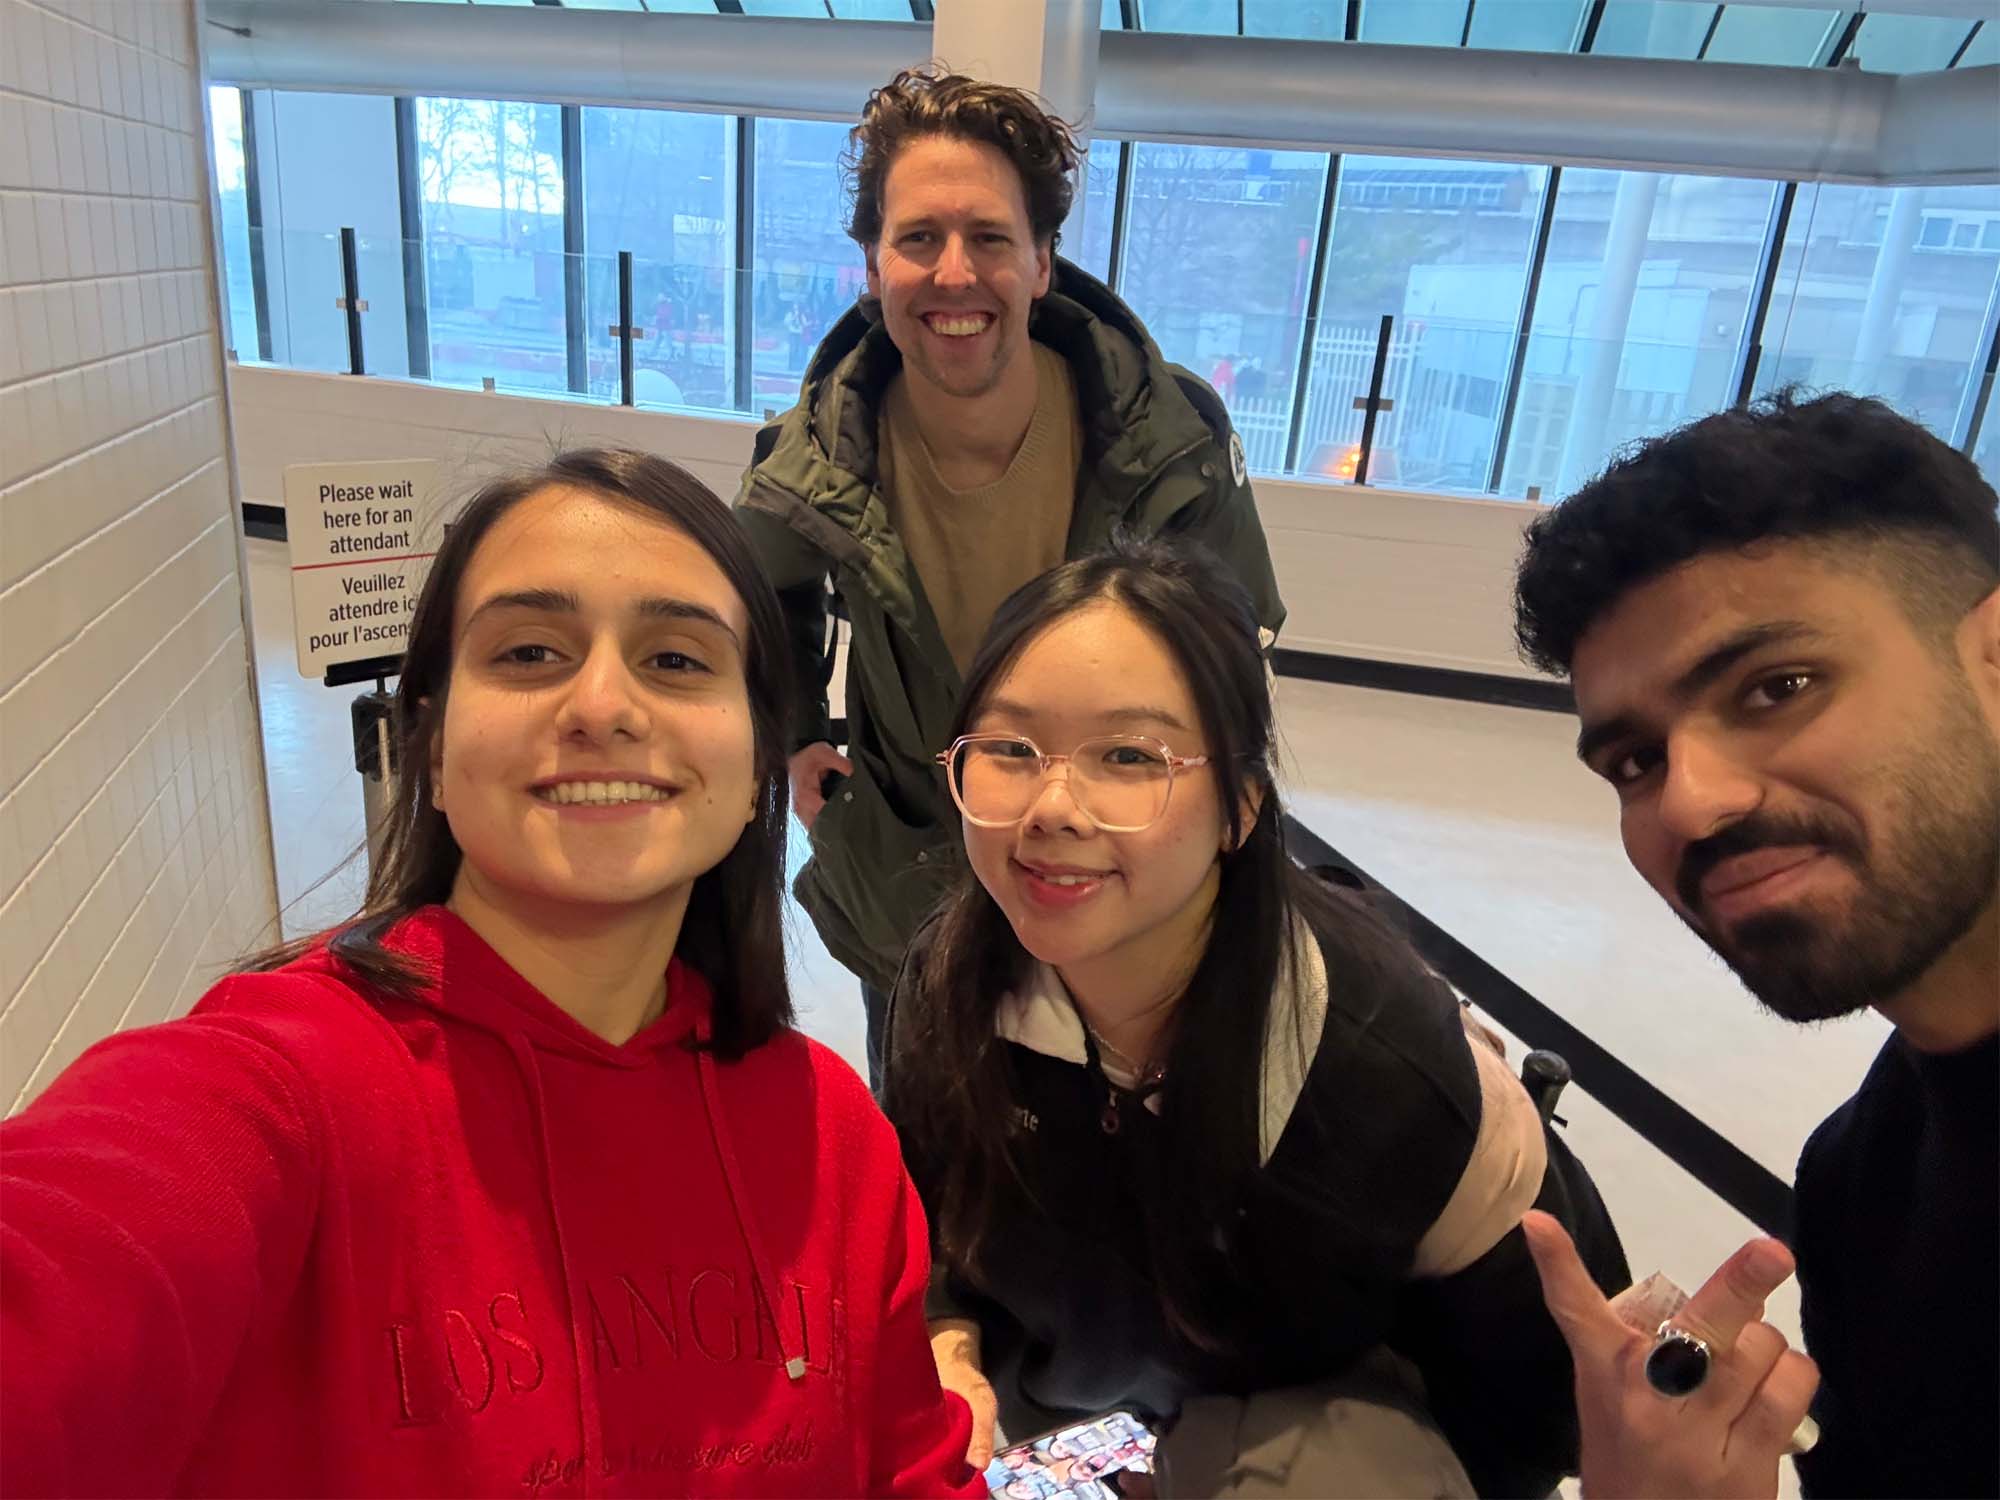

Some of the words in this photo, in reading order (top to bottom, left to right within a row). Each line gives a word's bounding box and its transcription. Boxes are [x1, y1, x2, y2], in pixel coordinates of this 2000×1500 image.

[320, 483, 375, 504] Please
[378, 480, 414, 499] wait
[324, 511, 361, 529] here
[366, 507, 389, 524] for
[394, 508, 413, 523] an
[330, 531, 410, 554] attendant
[342, 573, 405, 595] Veuillez
[329, 598, 399, 622] attendre
[310, 630, 349, 653] pour
[384, 1288, 545, 1428] LOS
